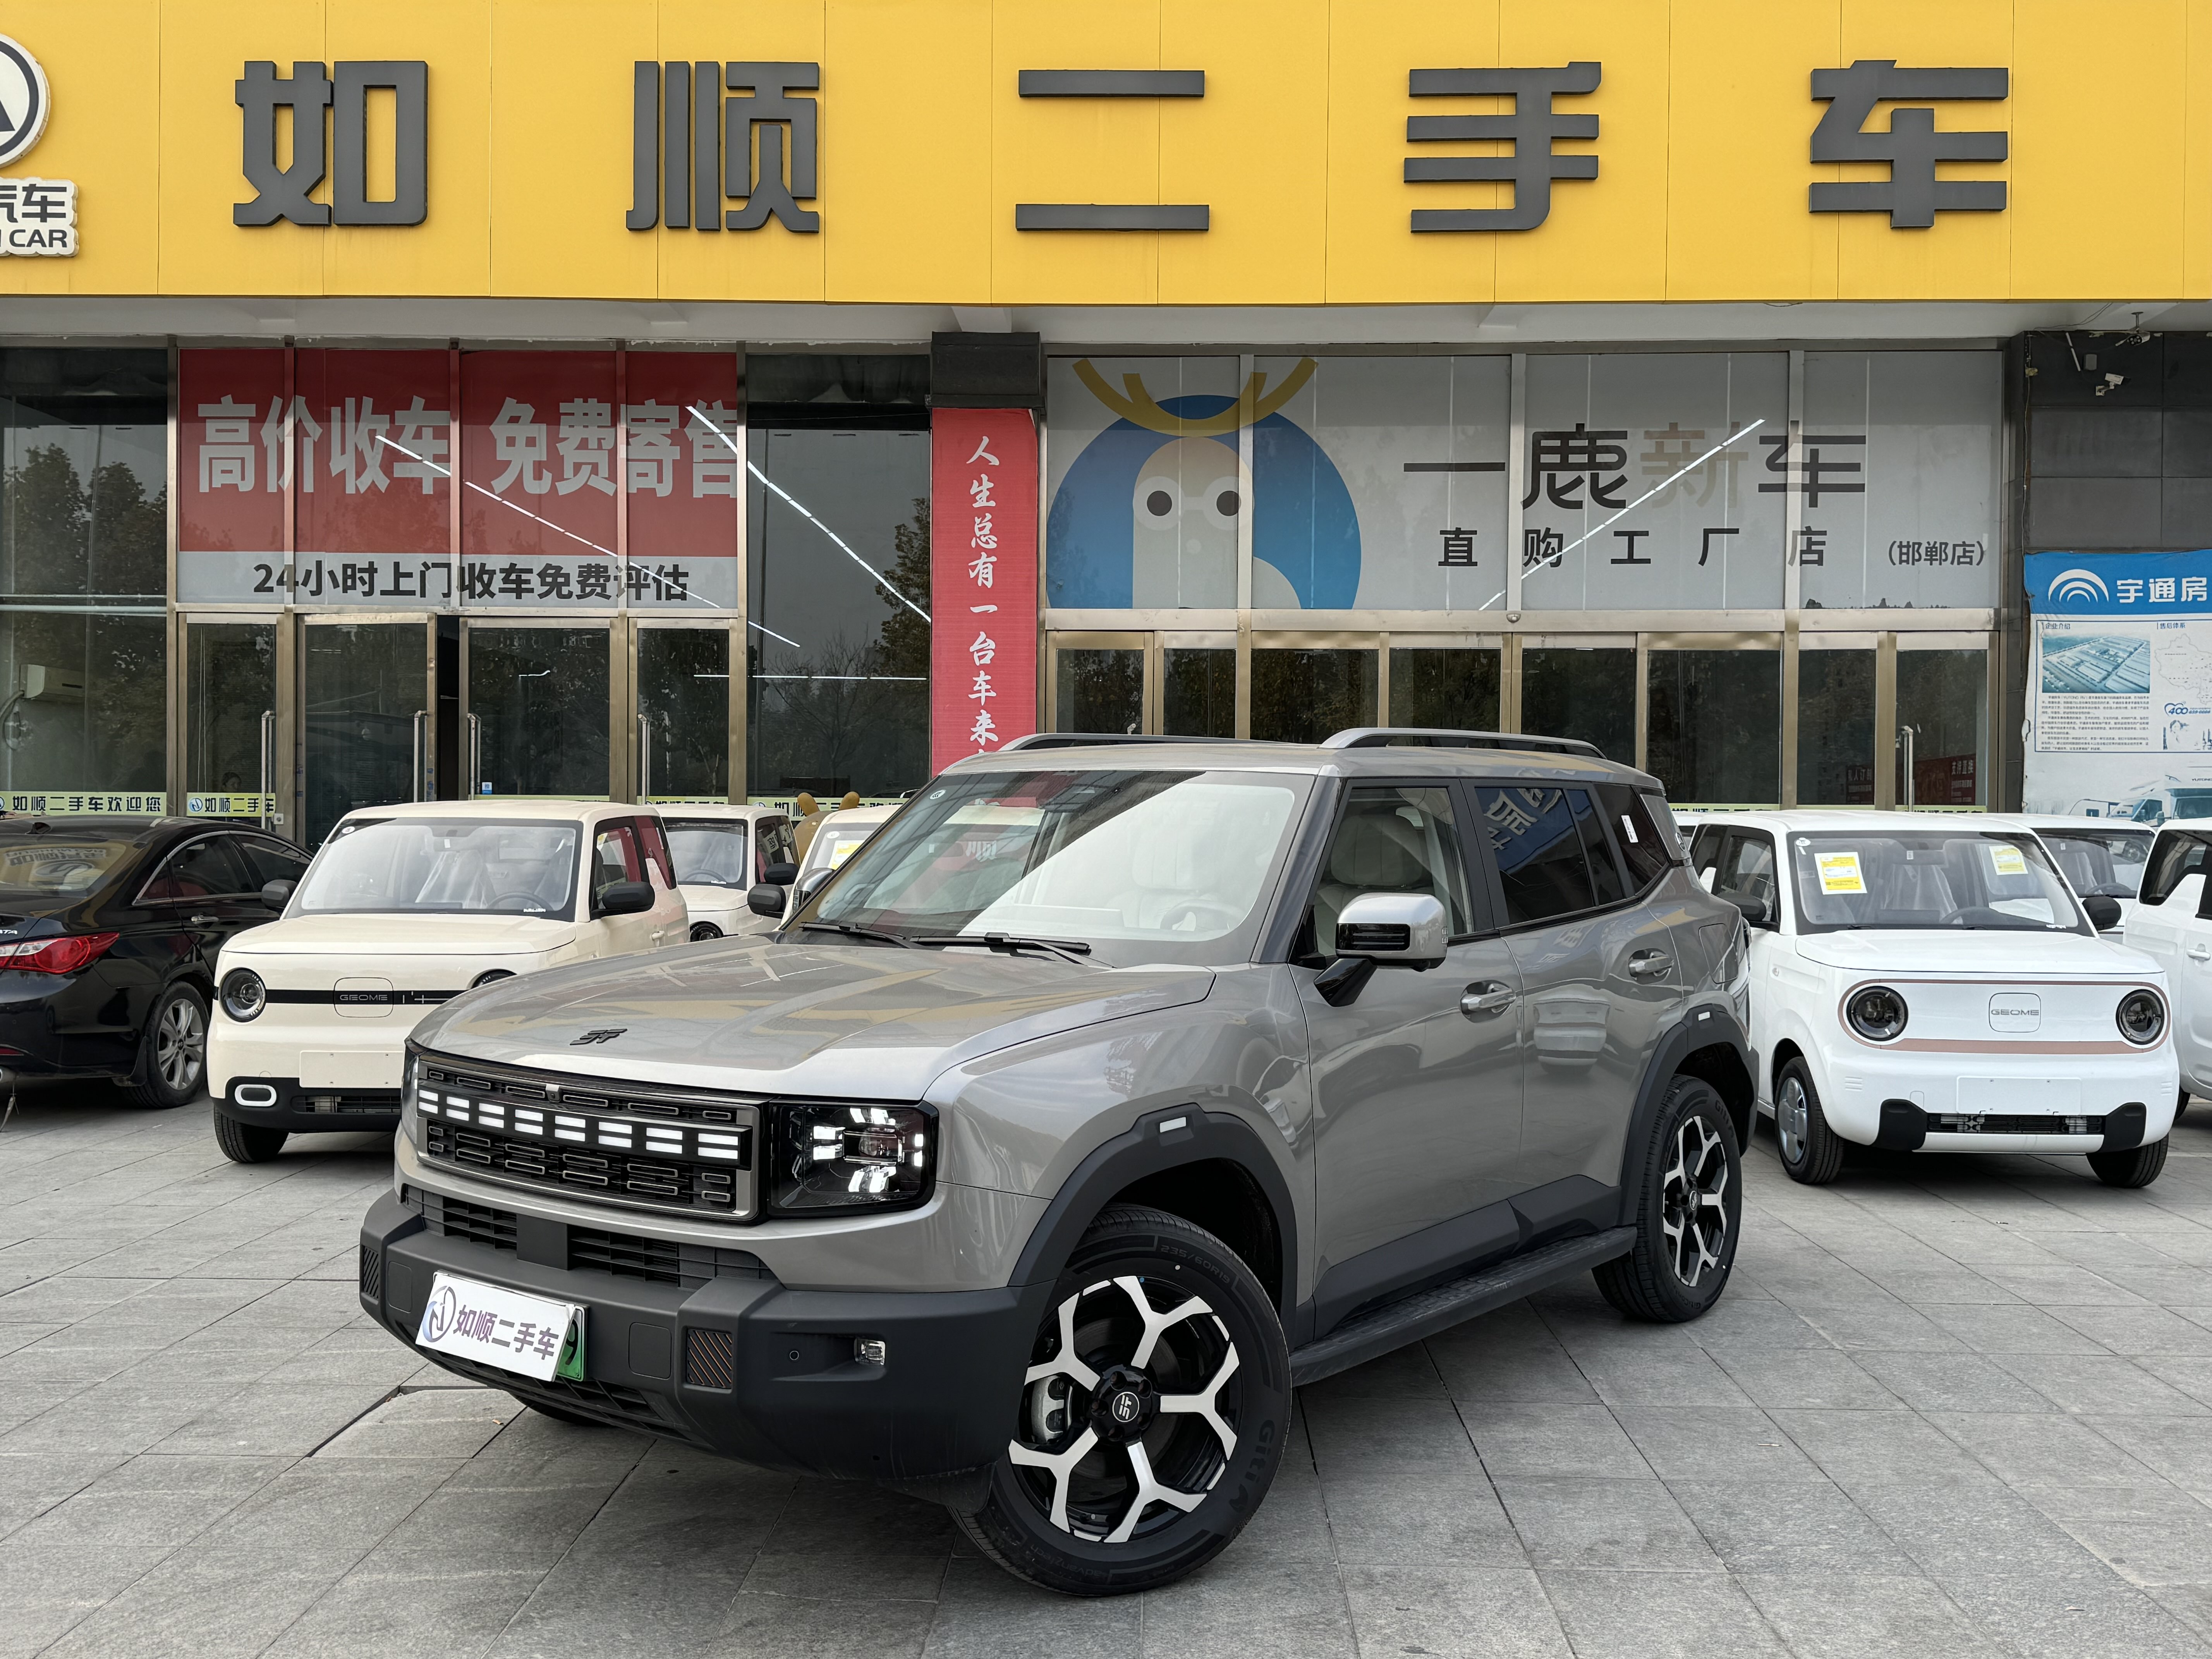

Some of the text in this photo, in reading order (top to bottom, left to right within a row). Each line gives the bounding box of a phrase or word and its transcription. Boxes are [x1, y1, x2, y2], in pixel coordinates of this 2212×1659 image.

[233, 60, 2008, 235] 如顺二手车
[9, 229, 67, 247] CAR
[198, 394, 738, 498] 高价收车 免费寄售
[1404, 421, 1866, 510] 一鹿新车
[1438, 526, 1827, 568] 直购工厂店
[253, 560, 689, 601] 24小时上门收车免费评估
[966, 436, 999, 753] 人生总有一台车来
[2117, 577, 2207, 603] 宇通房
[12, 796, 161, 812] 如顺二手车欢迎您
[205, 797, 274, 813] 如顺二手车
[453, 1304, 559, 1360] 如顺二手车
